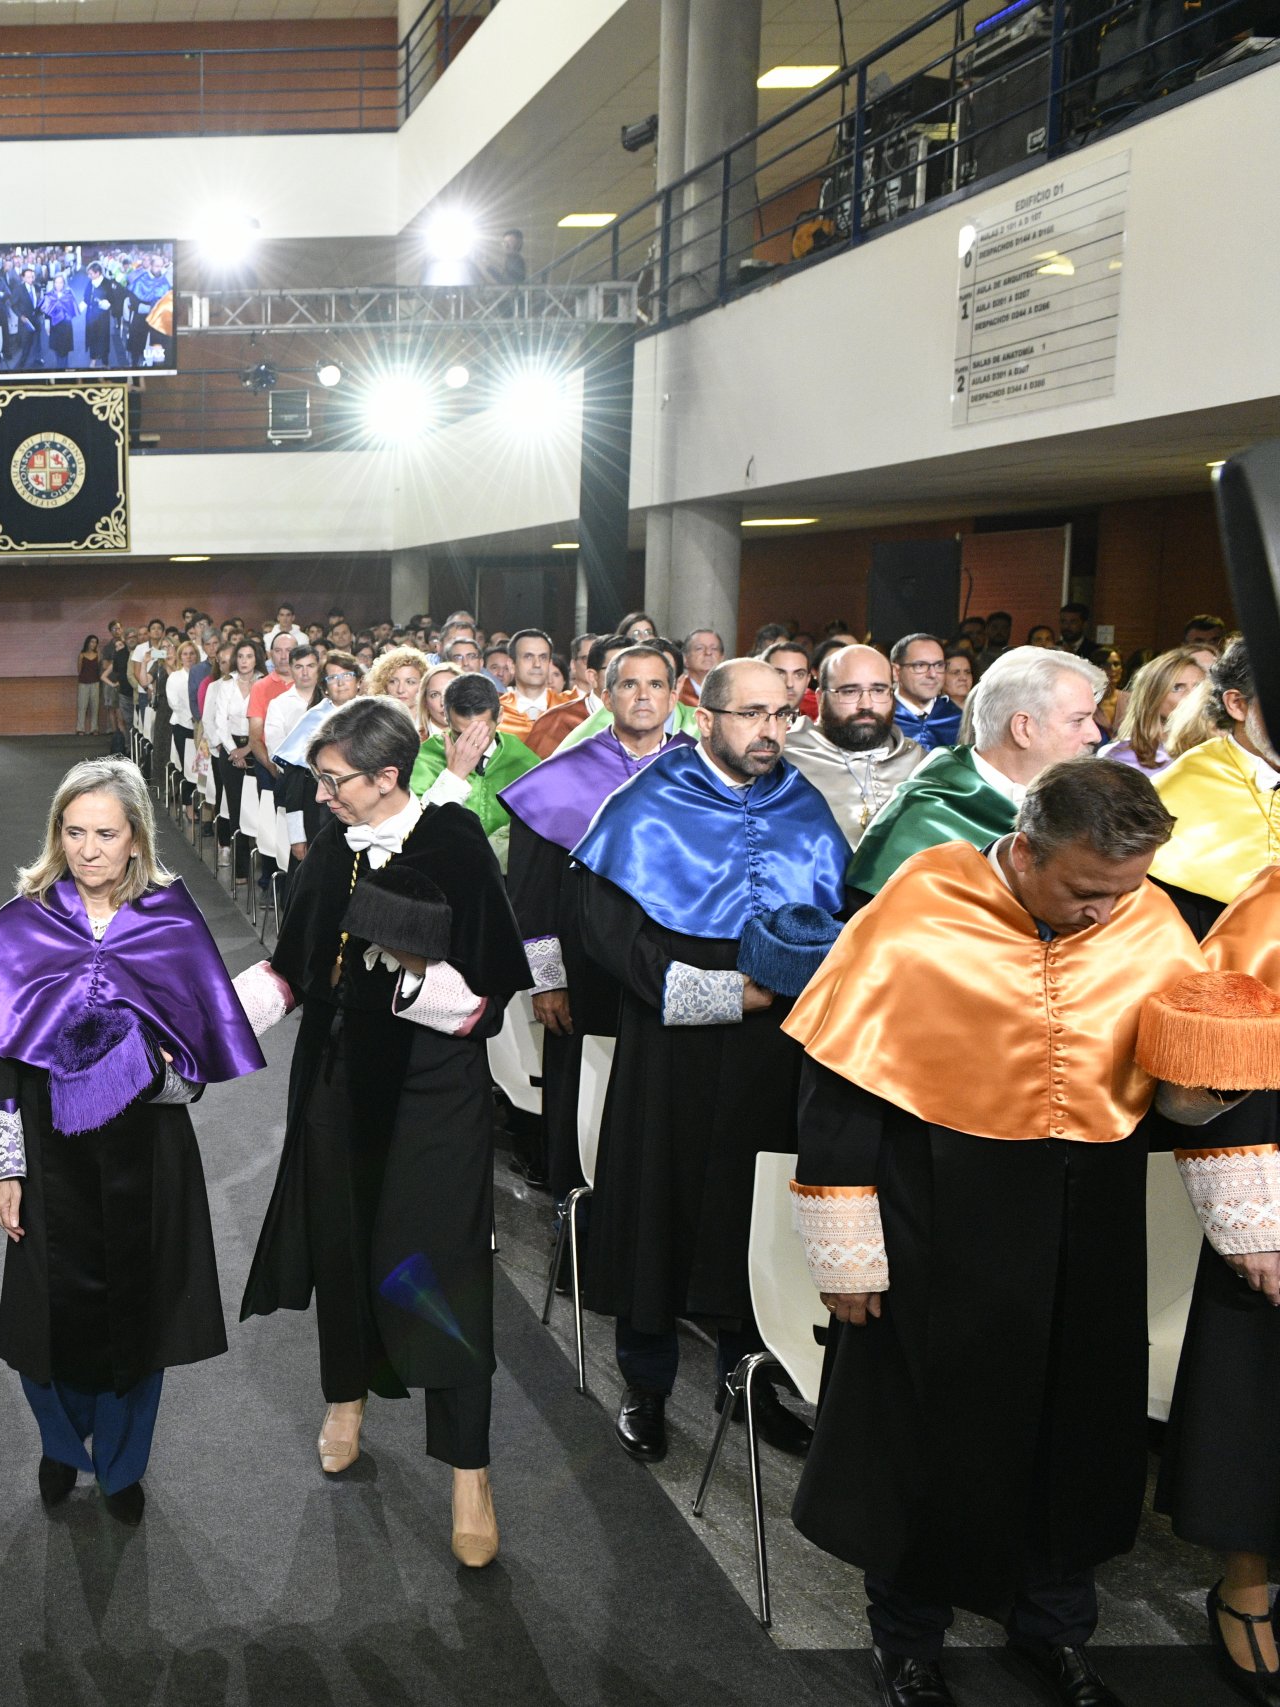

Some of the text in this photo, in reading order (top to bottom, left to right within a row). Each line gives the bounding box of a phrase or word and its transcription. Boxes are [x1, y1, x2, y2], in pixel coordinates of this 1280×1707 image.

[1014, 183, 1065, 212] EDIFICIO D1
[1002, 268, 1039, 286] ARQUITECT
[961, 302, 969, 320] 1
[972, 357, 992, 369] SALAS
[956, 375, 965, 393] 2
[62, 448, 73, 461] EL
[20, 450, 39, 495] ALFONSO
[50, 472, 76, 498] SABIO
